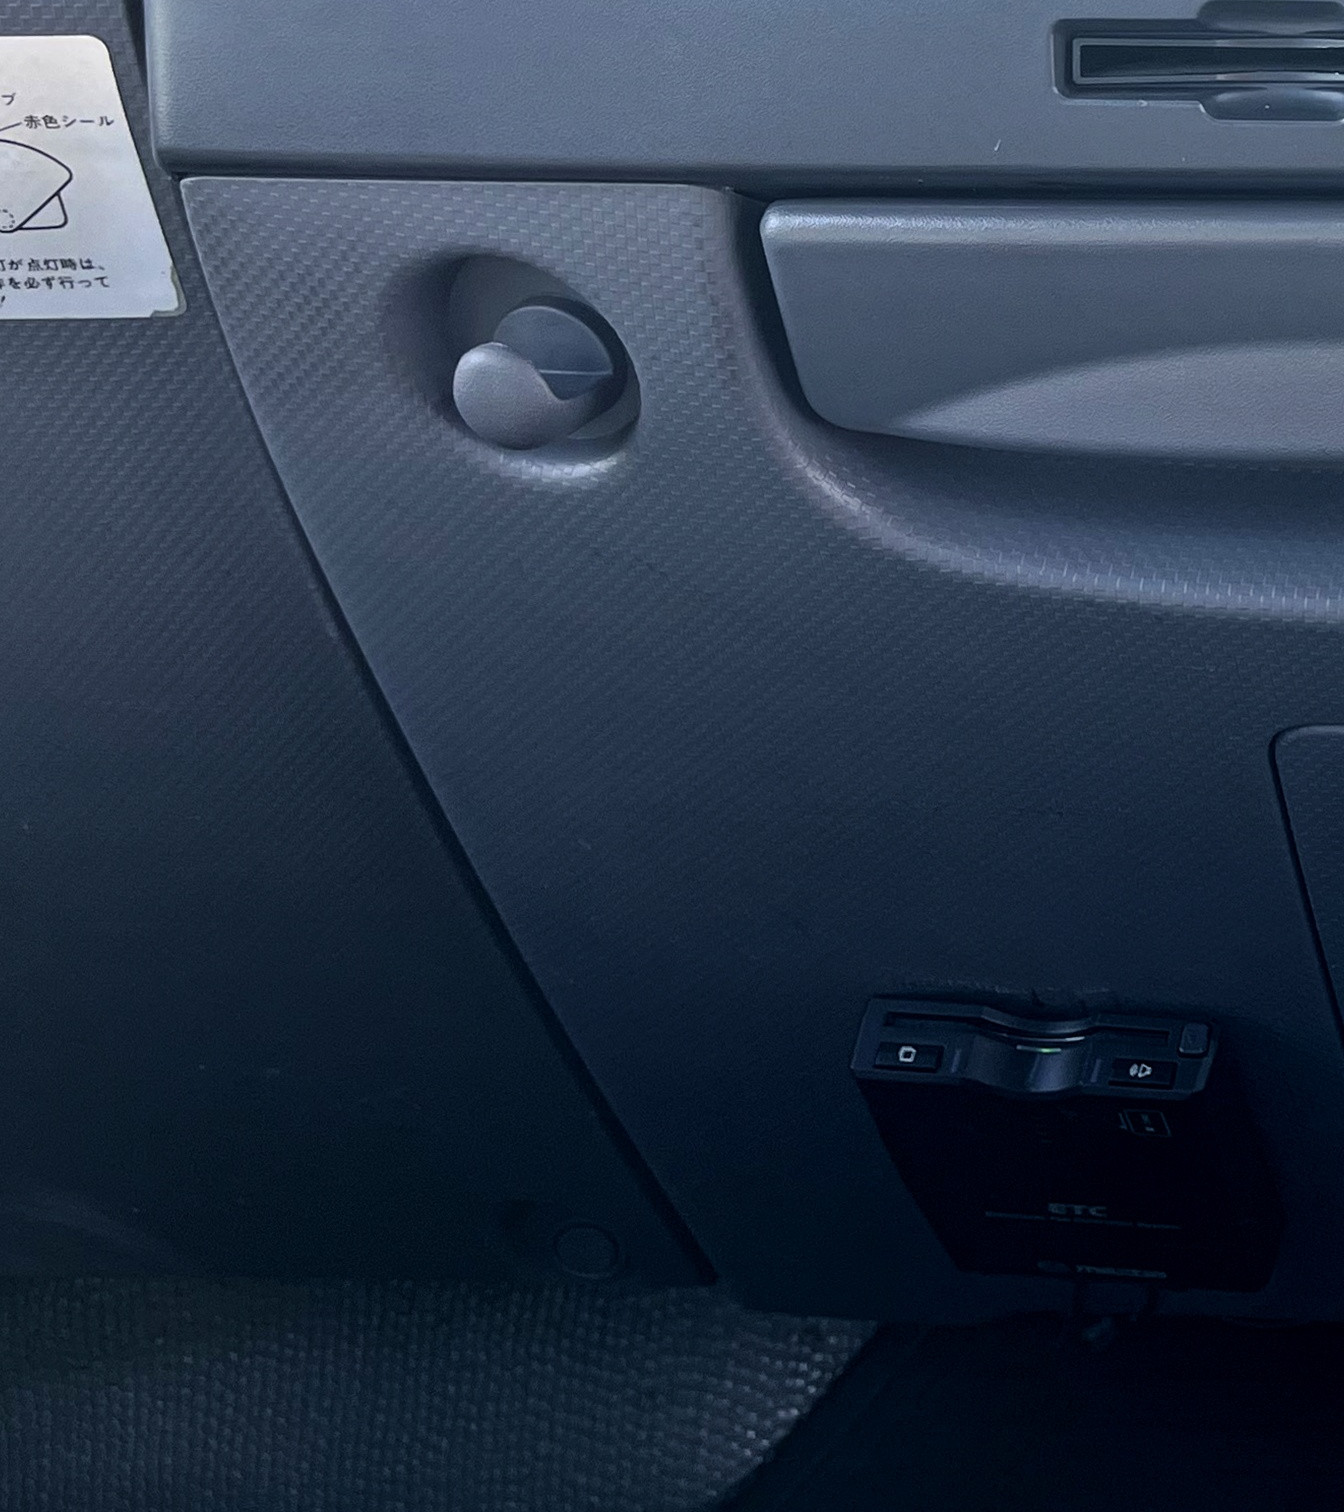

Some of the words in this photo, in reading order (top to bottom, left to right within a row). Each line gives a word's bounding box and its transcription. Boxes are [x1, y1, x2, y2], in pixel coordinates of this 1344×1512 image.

[24, 114, 115, 129] 赤色シール
[0, 276, 110, 289] を必ず行って
